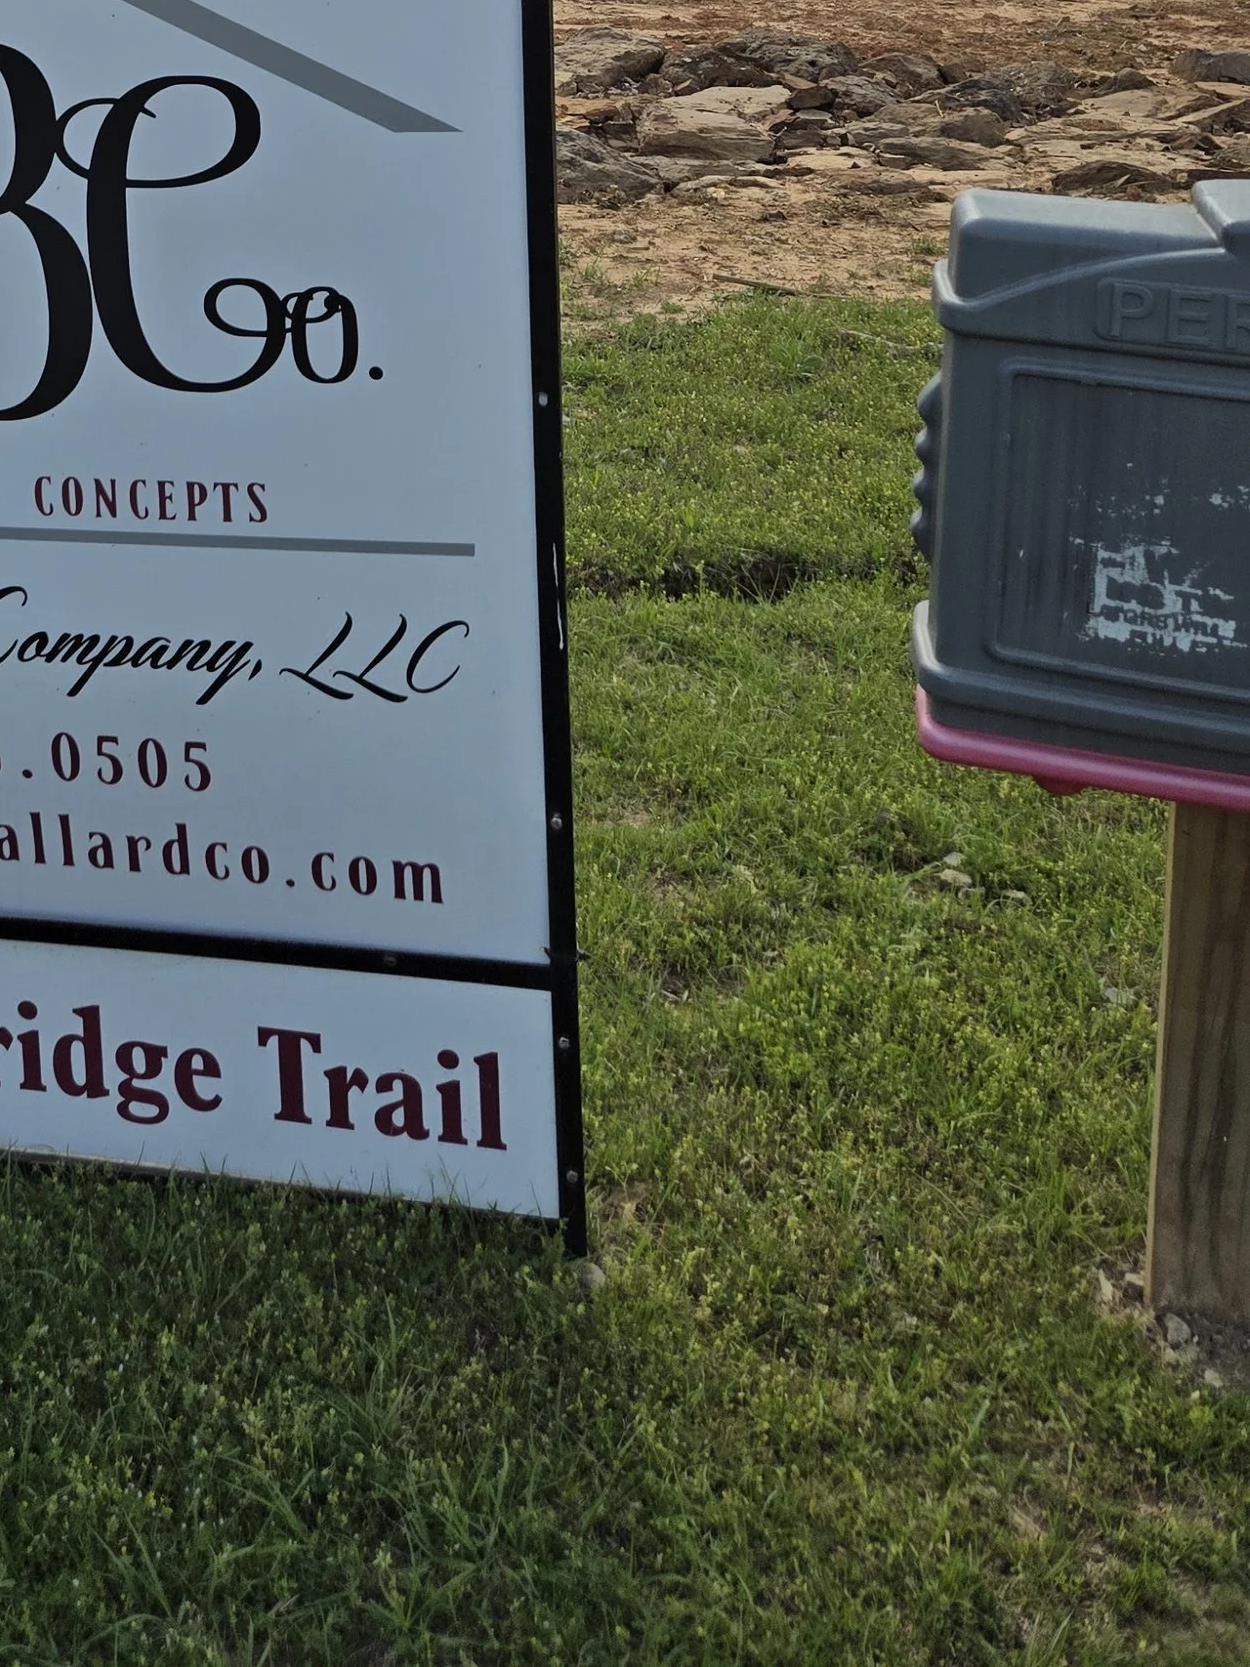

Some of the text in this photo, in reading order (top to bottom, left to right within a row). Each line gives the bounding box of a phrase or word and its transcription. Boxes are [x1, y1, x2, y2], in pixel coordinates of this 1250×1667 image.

[34, 475, 268, 524] CONCEPTS
[278, 610, 470, 704] LLC
[256, 1025, 508, 1152] Trail
